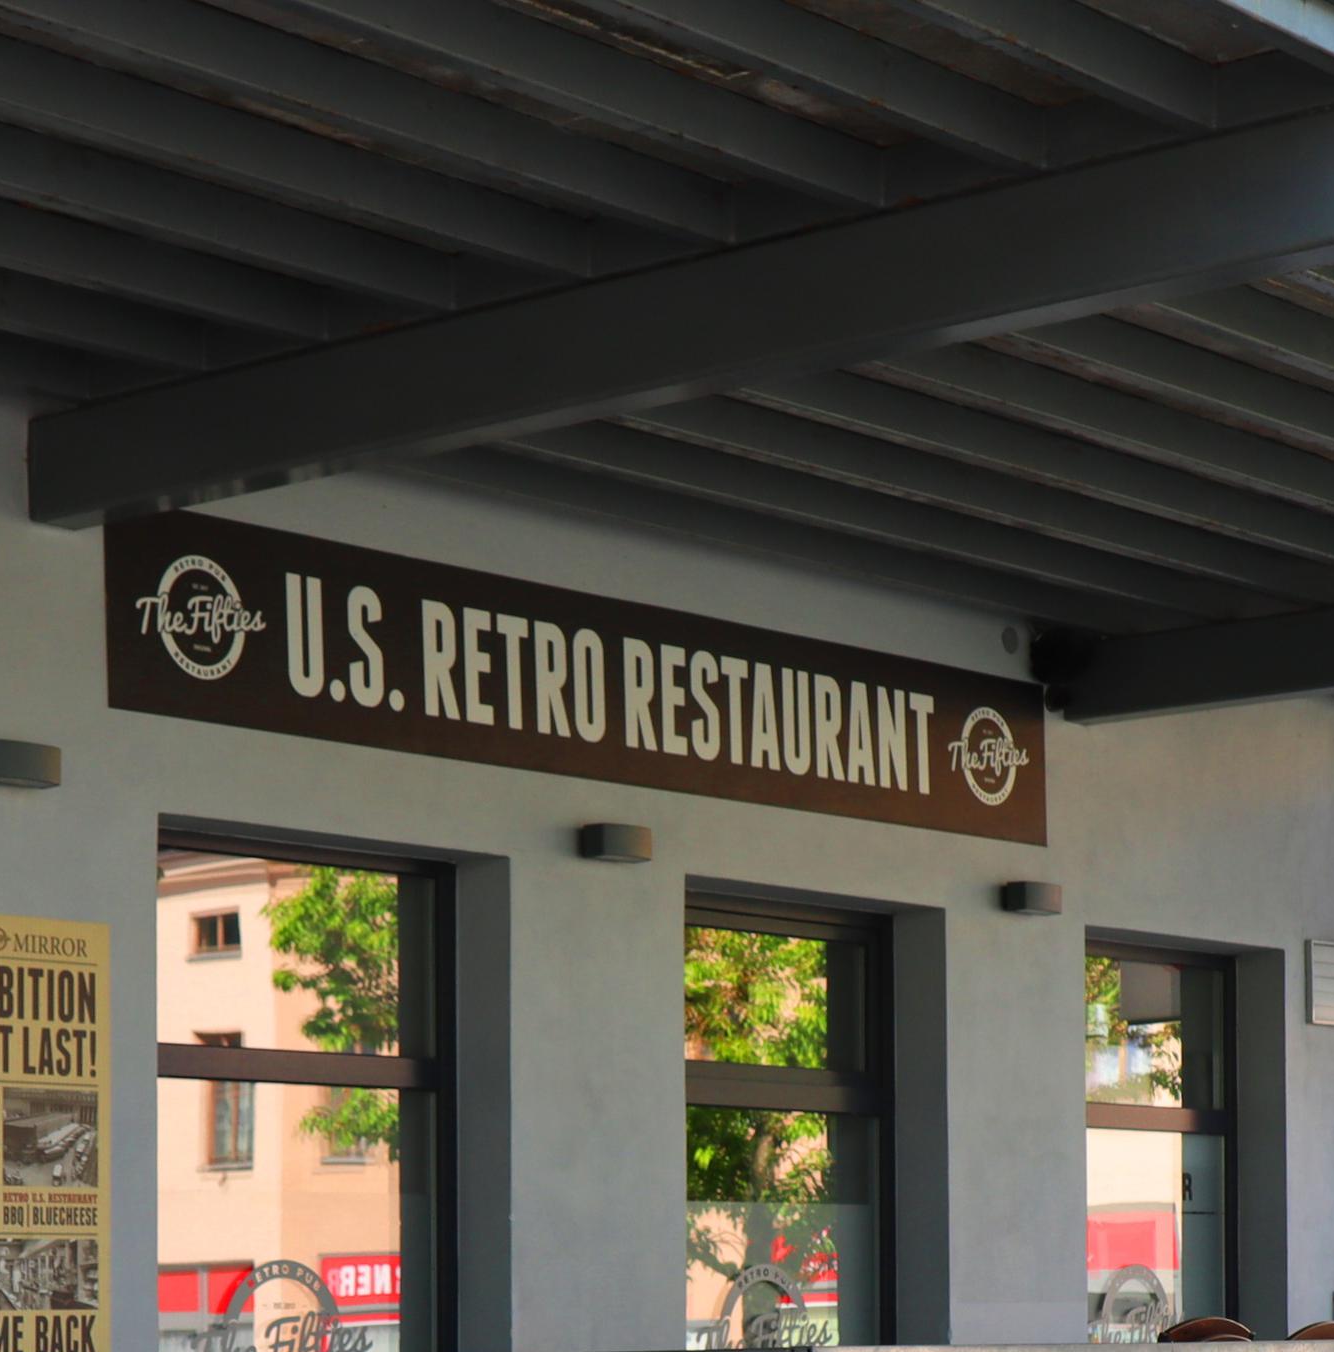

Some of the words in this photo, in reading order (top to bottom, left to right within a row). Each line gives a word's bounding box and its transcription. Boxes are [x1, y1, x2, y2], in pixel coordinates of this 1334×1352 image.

[135, 592, 186, 635] The
[184, 594, 267, 645] Fifties
[285, 571, 406, 713] U.S.
[421, 598, 607, 745] RETRO
[622, 636, 935, 796] RESTAURANT
[947, 736, 979, 772] The
[977, 736, 1030, 777] Fifties
[13, 933, 88, 959] MIRROR
[22, 1026, 97, 1078] LAST!
[3, 1206, 25, 1226] BBQ
[32, 1206, 98, 1226] BLUECHEESE
